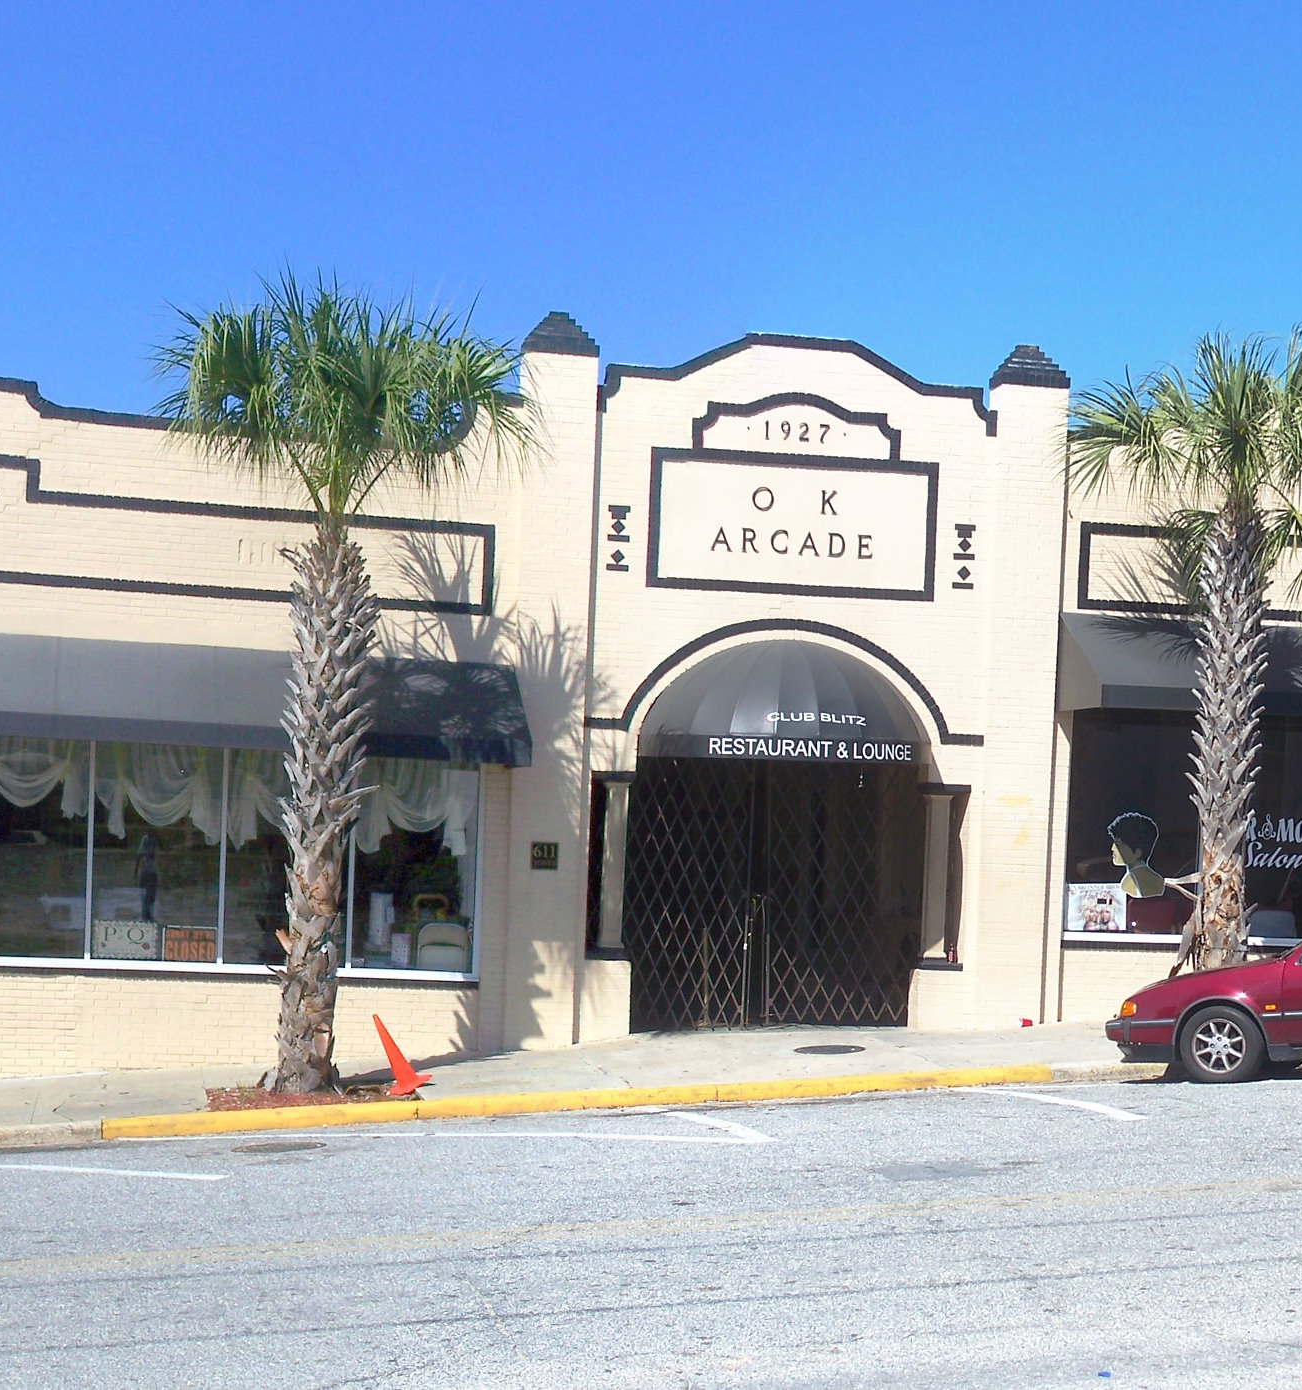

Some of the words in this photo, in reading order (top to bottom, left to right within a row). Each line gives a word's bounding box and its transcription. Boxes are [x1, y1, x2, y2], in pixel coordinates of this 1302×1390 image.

[764, 420, 831, 444] 1927
[752, 486, 775, 511] O
[820, 489, 838, 515] K
[710, 526, 874, 560] ARCADE
[766, 711, 816, 722] CLUB
[820, 712, 867, 726] BLITZ
[708, 737, 833, 758] RESTAURANT
[836, 741, 849, 759] &
[853, 742, 912, 761] LOUNGE
[533, 845, 555, 858] 611
[103, 926, 117, 942] P
[126, 926, 145, 945] Q
[165, 940, 216, 962] CLOSED
